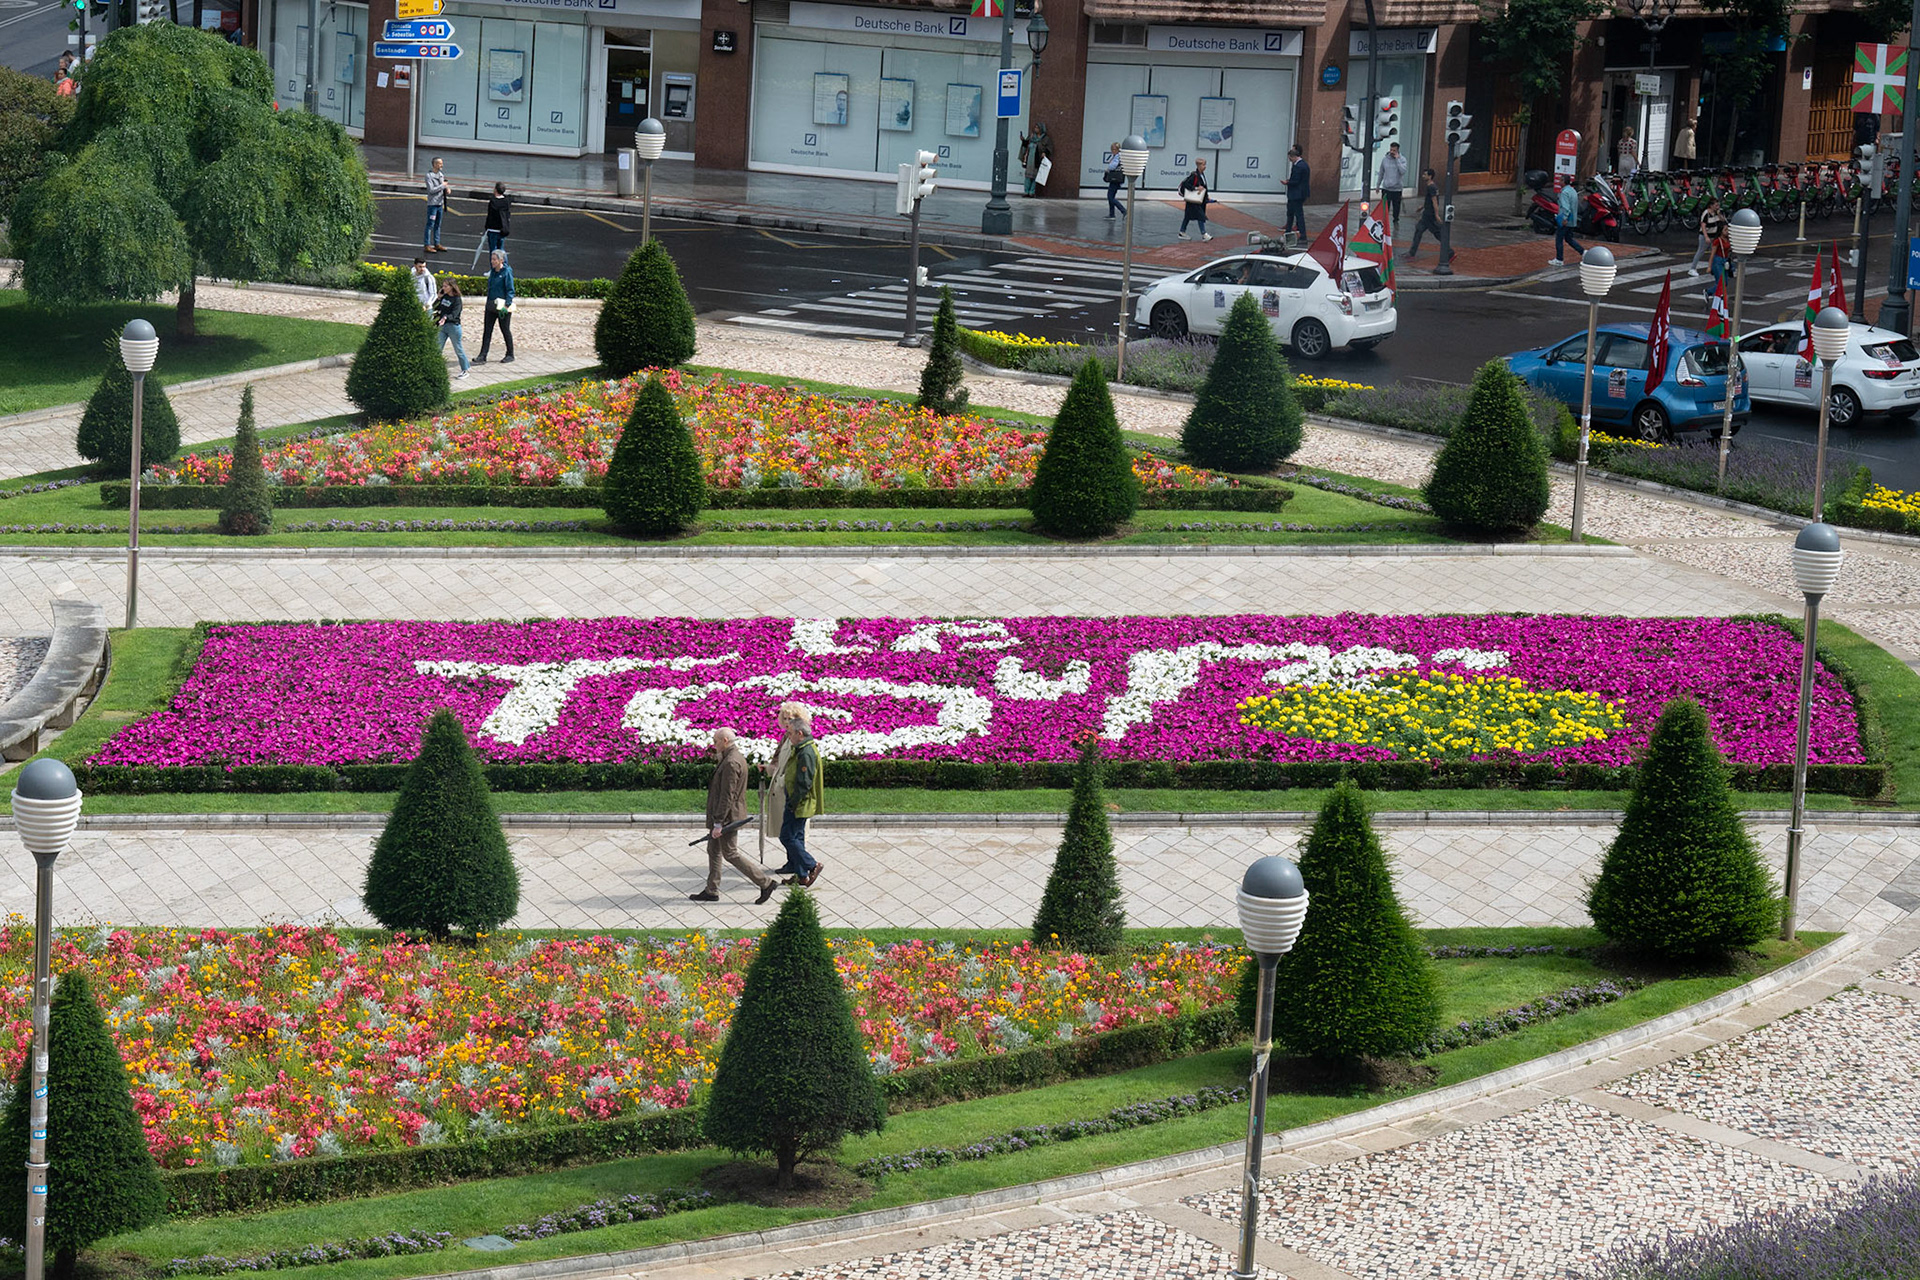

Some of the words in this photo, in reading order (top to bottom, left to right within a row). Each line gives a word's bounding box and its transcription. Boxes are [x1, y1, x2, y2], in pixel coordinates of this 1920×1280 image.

[855, 16, 911, 32] Deutsche
[914, 20, 945, 35] Bank
[1168, 36, 1226, 50] Deutsche
[1229, 38, 1260, 51] Bank
[1357, 40, 1394, 52] Desche
[1395, 39, 1415, 51] Bank
[431, 117, 454, 126] Deutsche
[484, 122, 508, 131] Deutsche
[508, 124, 522, 132] Bank
[536, 126, 561, 135] Deutsche
[790, 148, 815, 156] Deutsche
[1160, 169, 1185, 177] Deutsche
[1232, 172, 1257, 180] Deutsche
